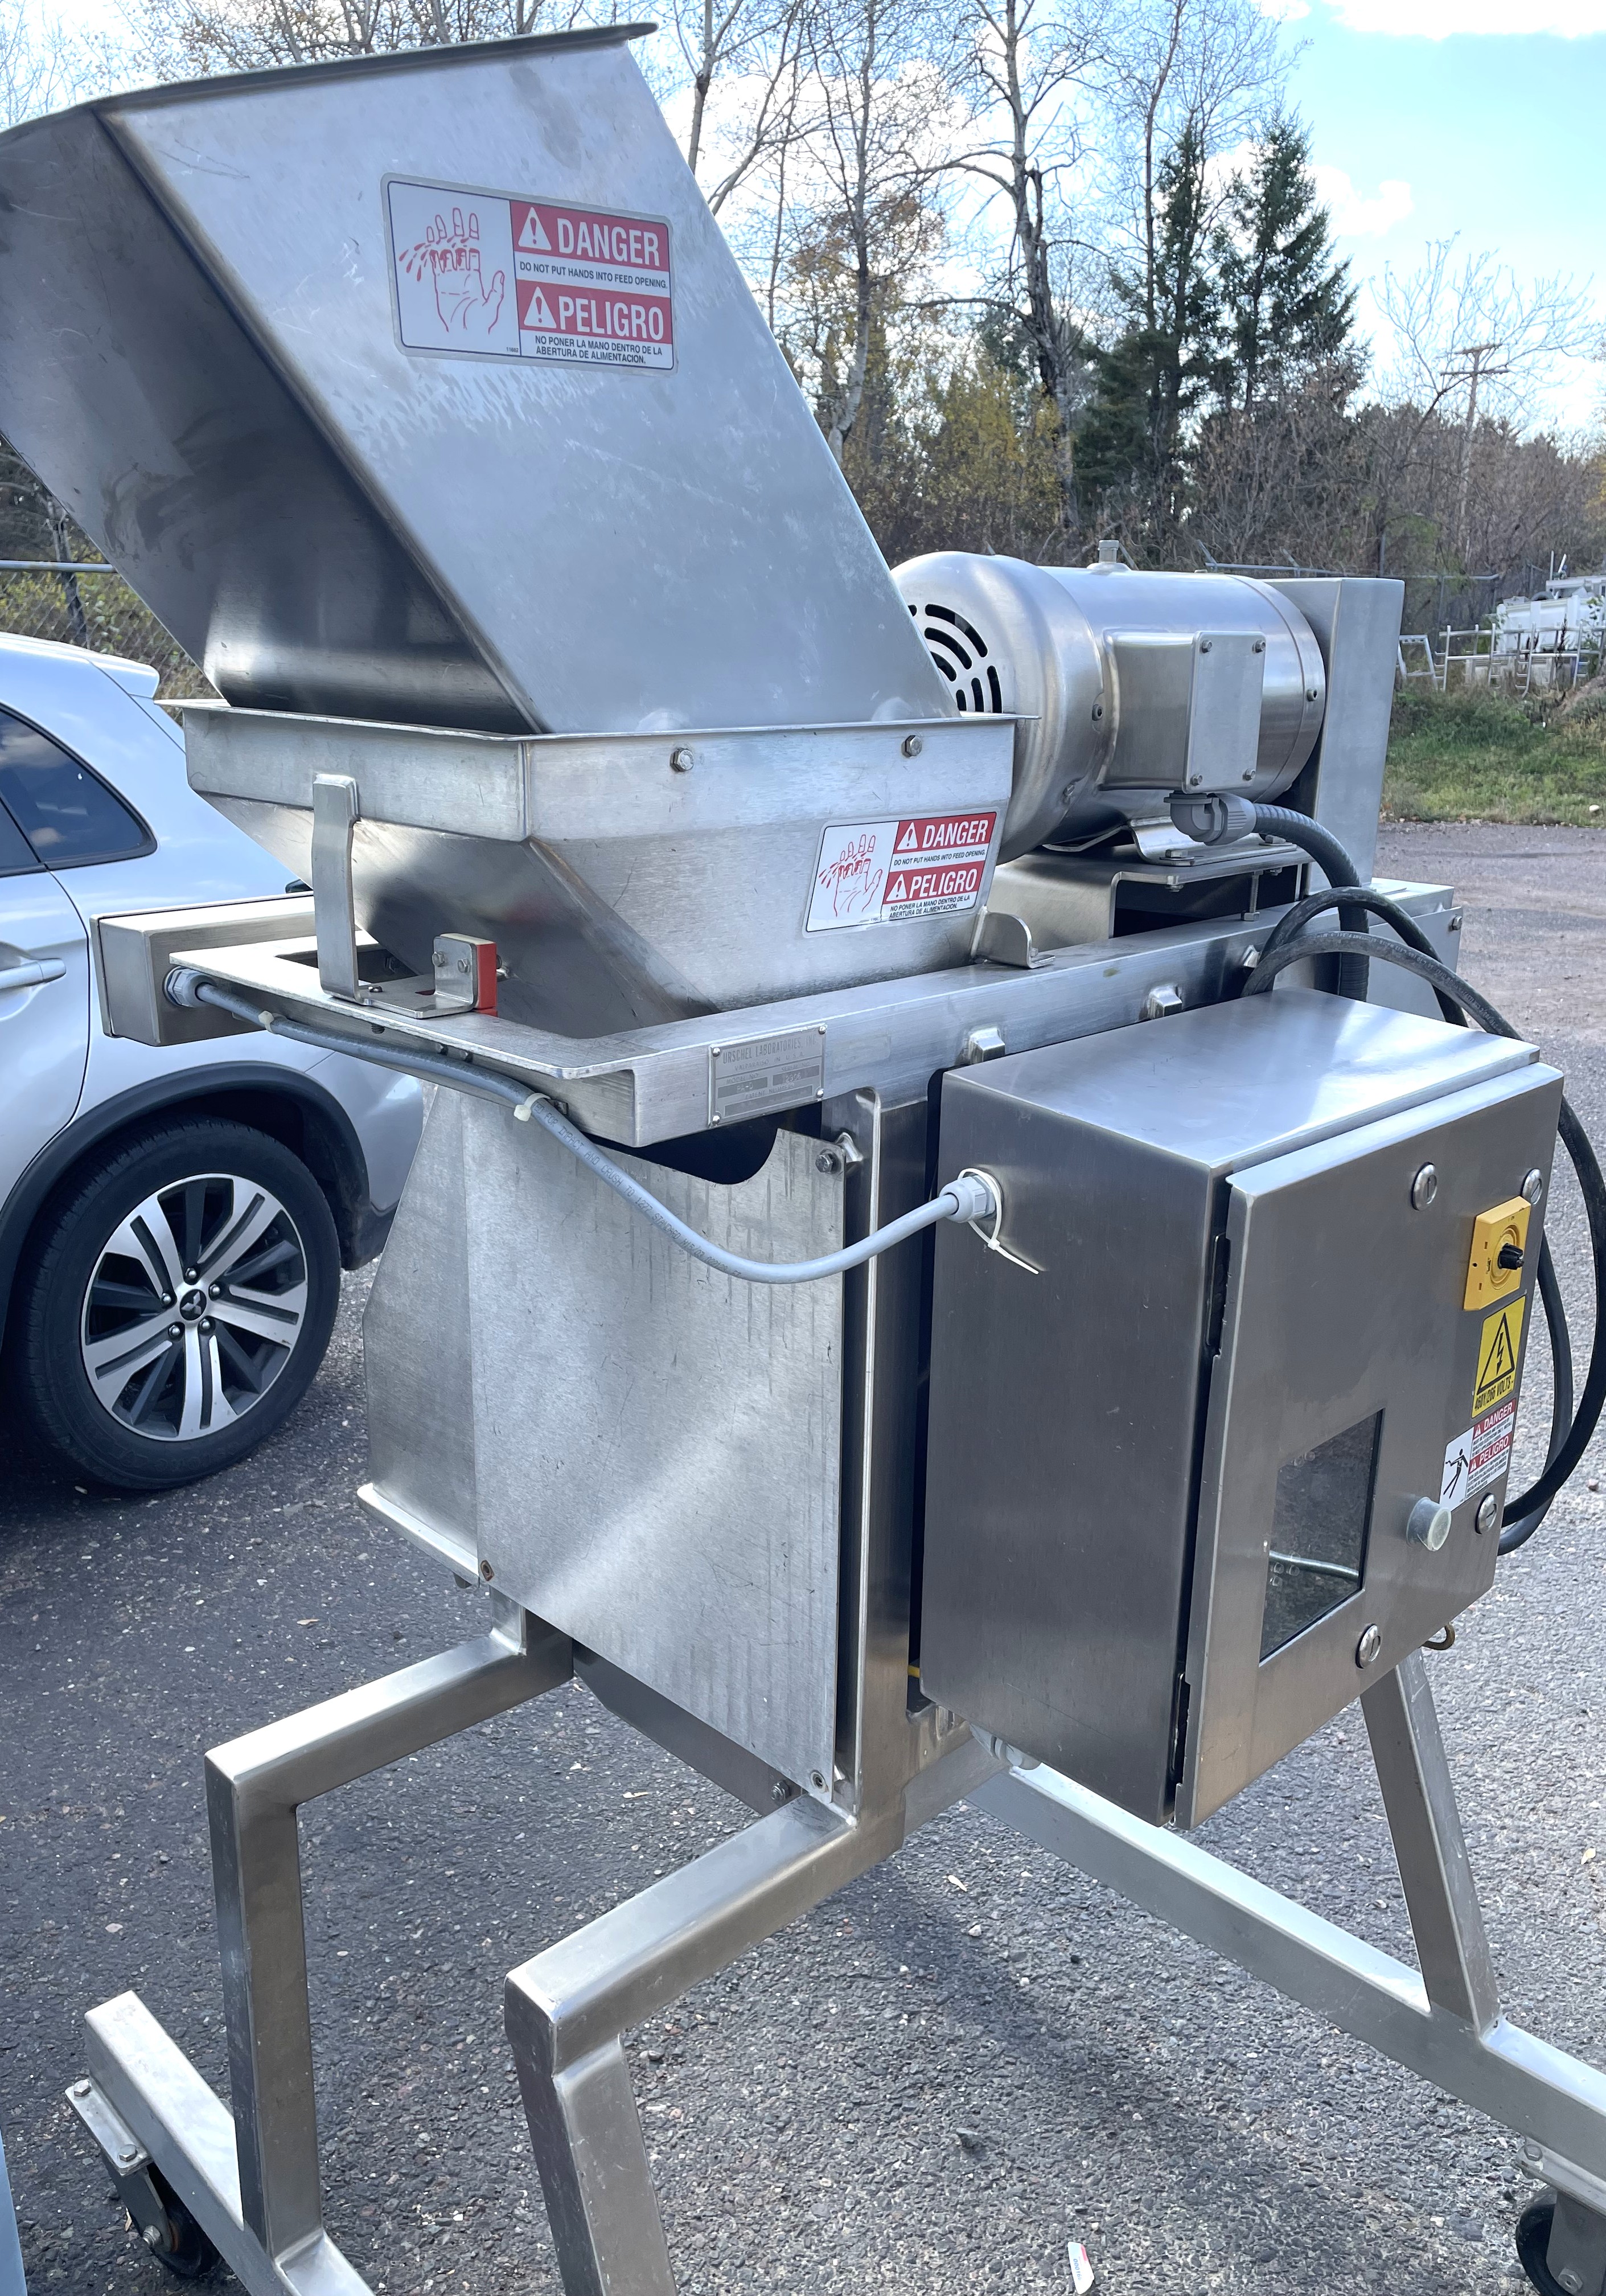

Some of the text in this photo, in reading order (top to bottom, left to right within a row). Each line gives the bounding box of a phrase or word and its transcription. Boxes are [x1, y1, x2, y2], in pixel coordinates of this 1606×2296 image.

[557, 218, 660, 266] DANGER
[520, 262, 668, 289] DO NOT PUT HANDS INTO FEED OPENING.
[558, 296, 663, 340] PELIGRO
[535, 335, 662, 355] NO PONER LA MANO DENTRO DE LA
[536, 346, 646, 363] ABERTURA DE ALIMENTACION.
[922, 819, 988, 848] DANGER
[909, 868, 977, 899] PELIGRO
[889, 910, 914, 919] ABERTURA
[938, 897, 956, 905] DENTRO
[723, 1048, 752, 1064] URSCHEL
[543, 1112, 559, 1127] FOR
[557, 1125, 585, 1151] IMPACT
[584, 1149, 601, 1166] AND
[599, 1163, 625, 1187] CRUSH
[623, 1184, 636, 1198] TO
[634, 1196, 653, 1214] 1277
[1497, 1375, 1511, 1397] VOLTS
[1484, 1402, 1513, 1429] DANGER
[1479, 1436, 1509, 1465] PELIGRO
